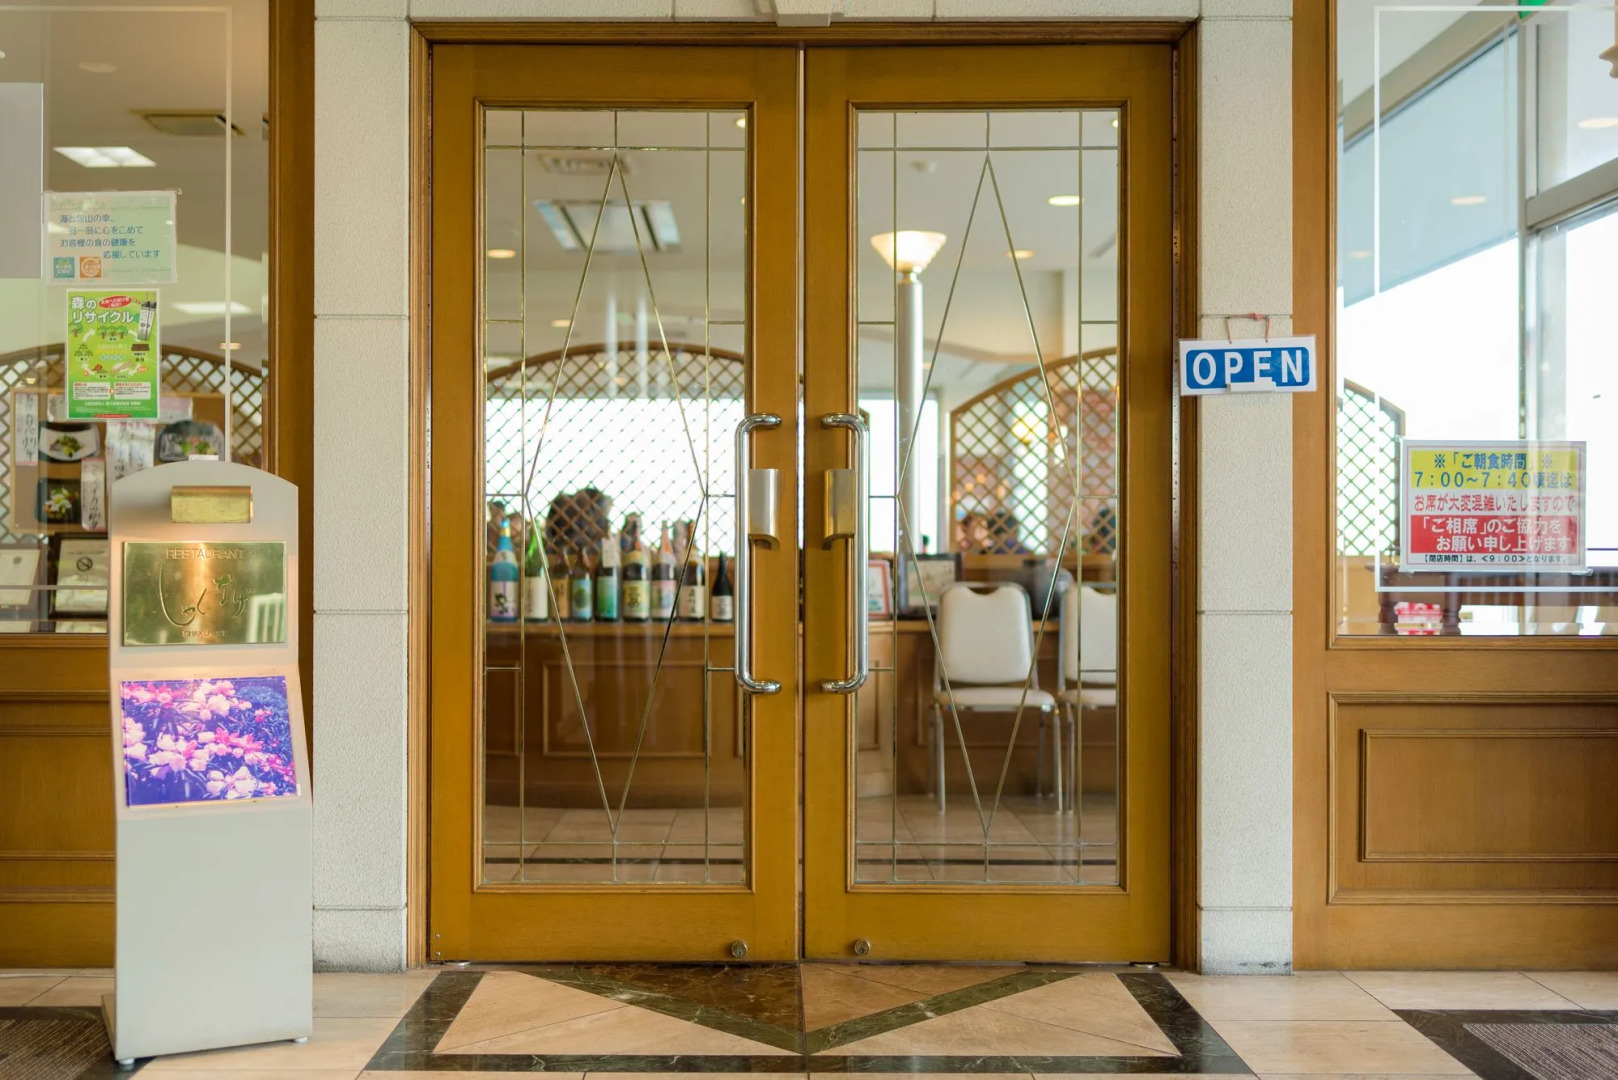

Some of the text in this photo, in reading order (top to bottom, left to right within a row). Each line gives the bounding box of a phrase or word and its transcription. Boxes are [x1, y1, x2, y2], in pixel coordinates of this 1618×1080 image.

[71, 296, 97, 310] 森の
[72, 311, 134, 324] リサイクル
[1192, 350, 1303, 386] OPEN
[1423, 516, 1562, 535] 「ご相席」のご協力を
[1436, 536, 1572, 552] お願い申し上げます
[166, 548, 245, 560] RESTAURANT
